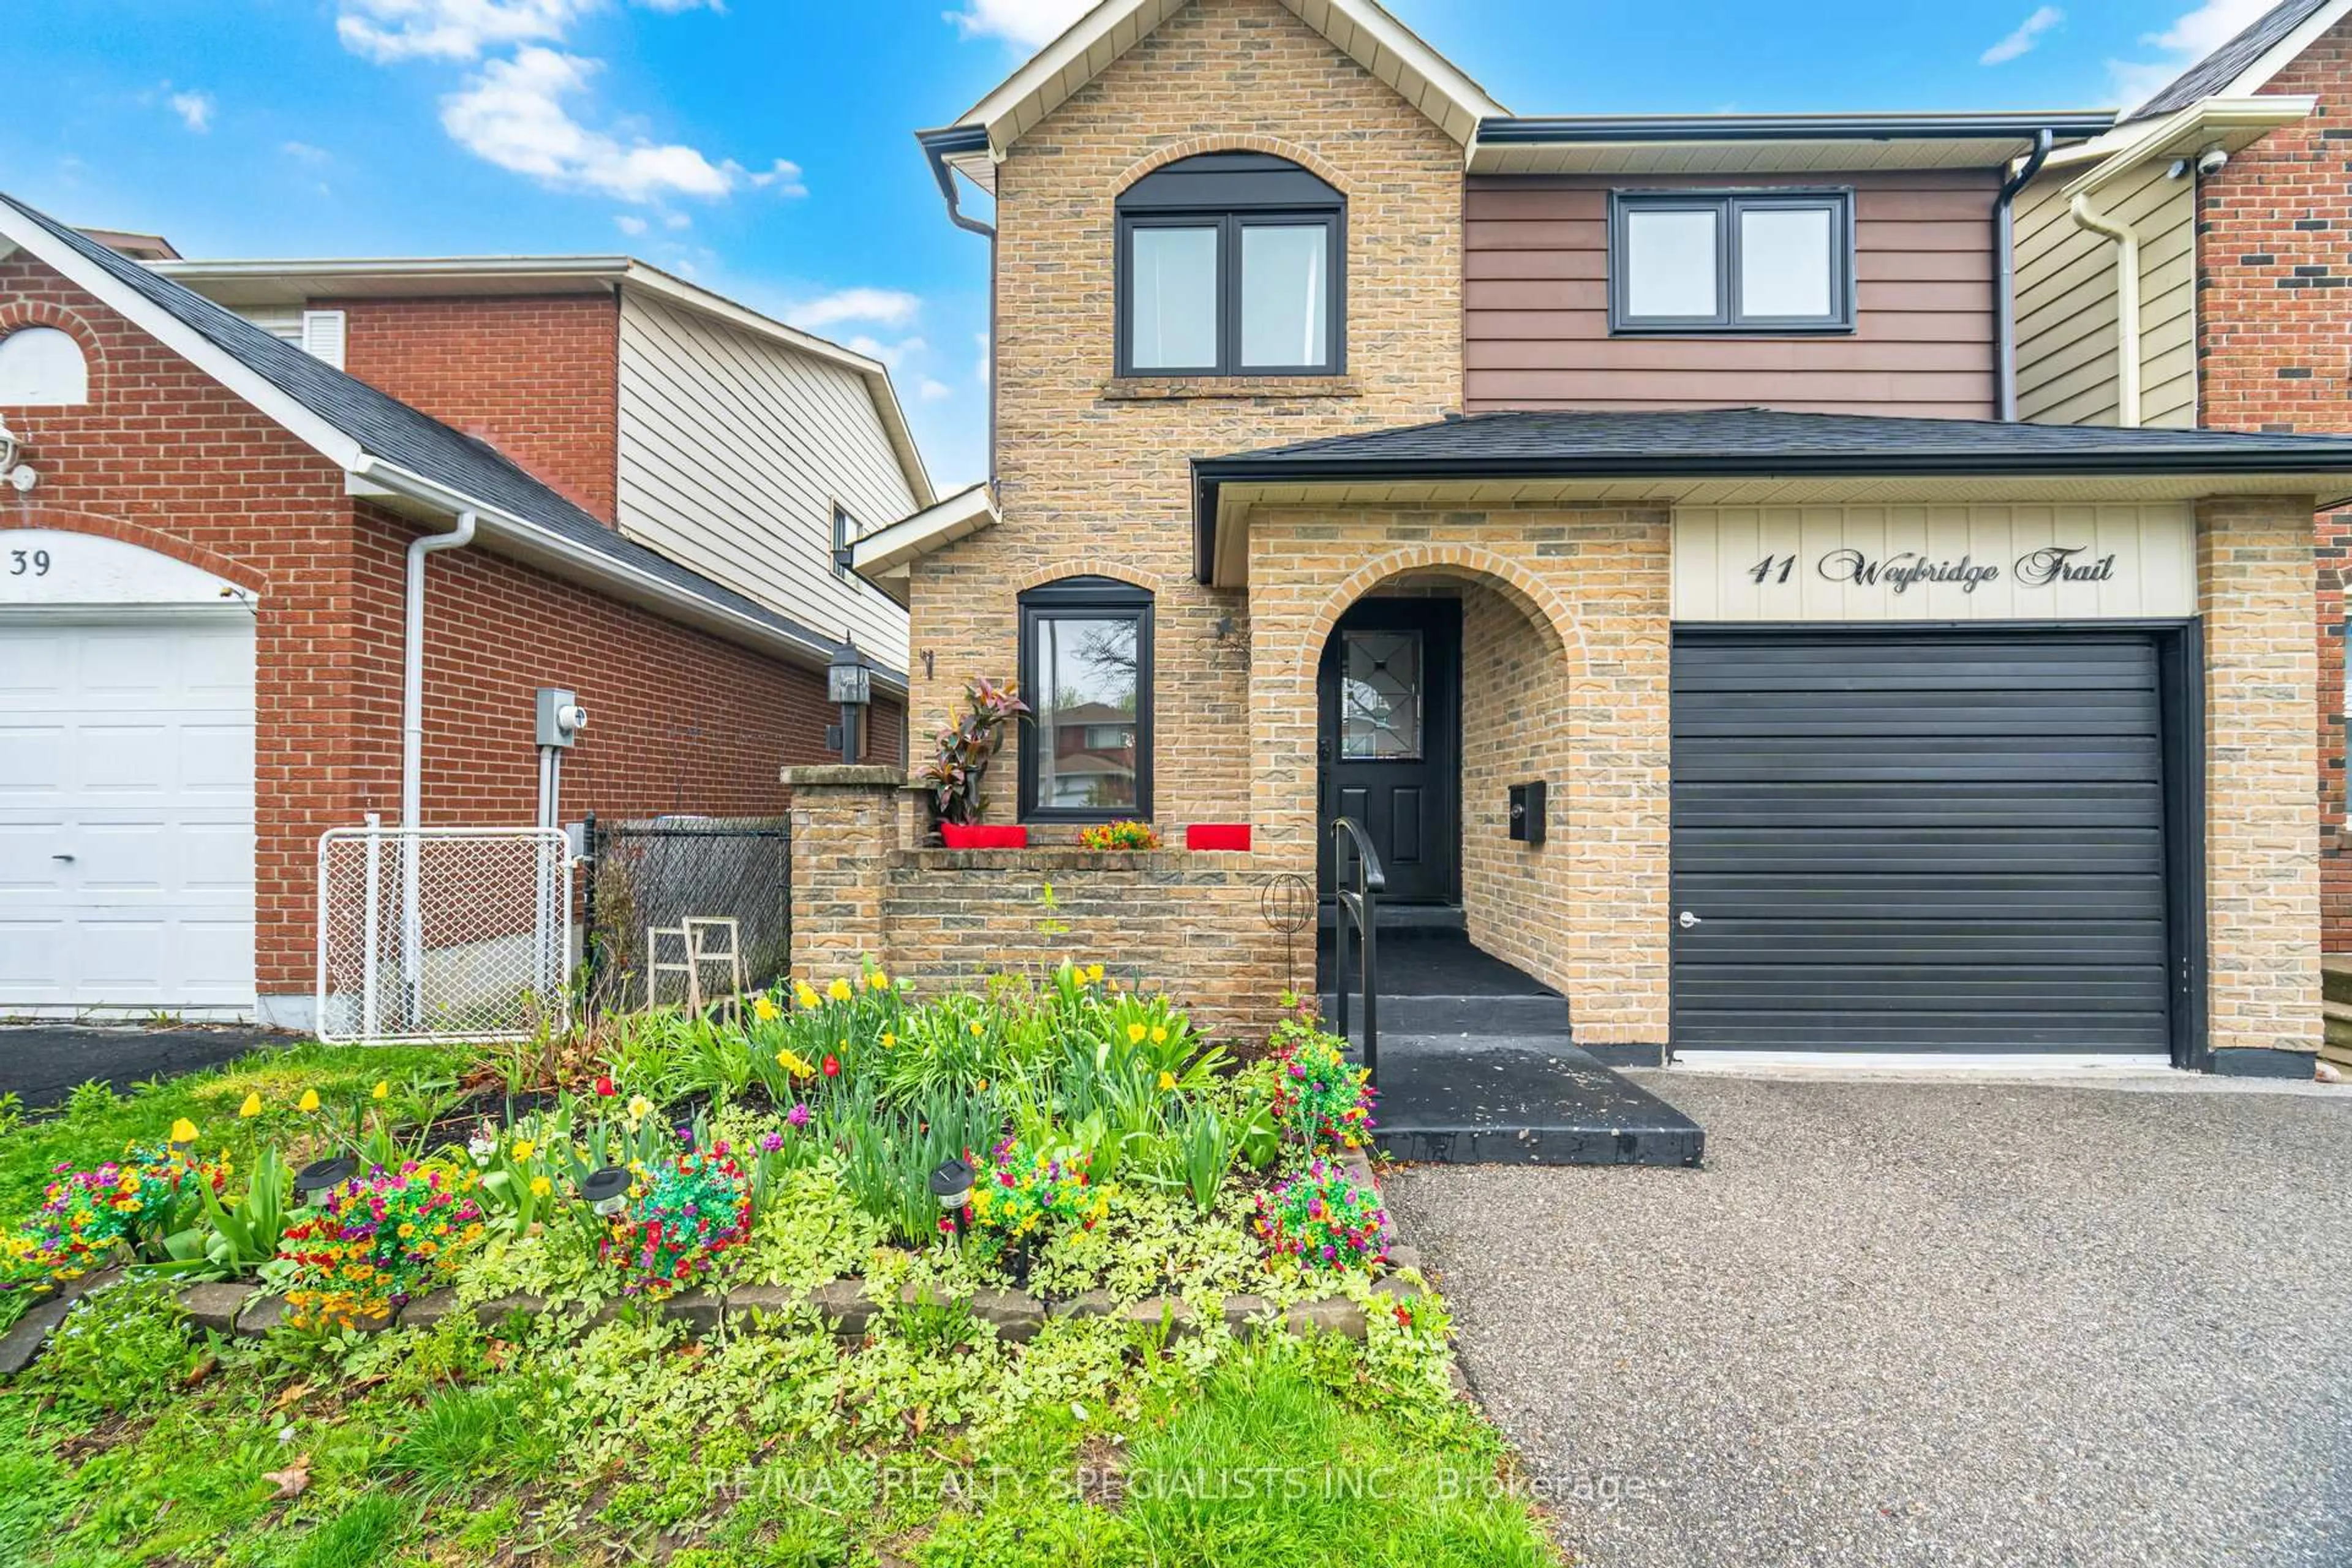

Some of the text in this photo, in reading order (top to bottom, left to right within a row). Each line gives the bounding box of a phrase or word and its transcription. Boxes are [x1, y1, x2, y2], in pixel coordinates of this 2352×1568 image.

[10, 549, 50, 576] 39
[1749, 546, 2117, 594] 41 Weybridge Trail
